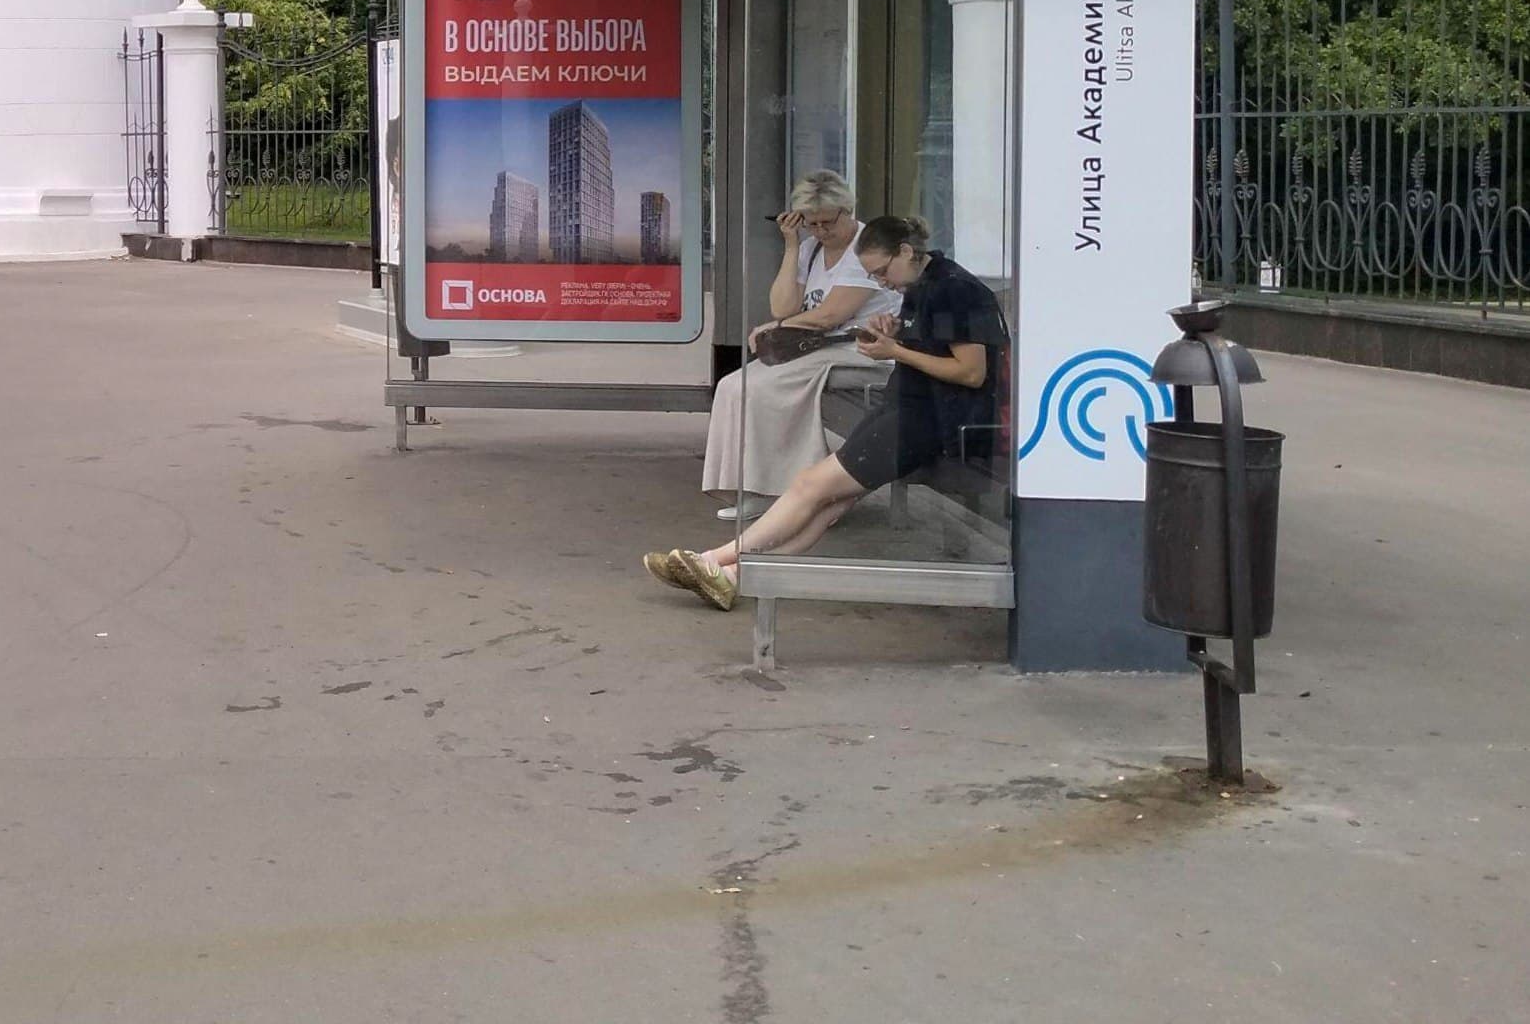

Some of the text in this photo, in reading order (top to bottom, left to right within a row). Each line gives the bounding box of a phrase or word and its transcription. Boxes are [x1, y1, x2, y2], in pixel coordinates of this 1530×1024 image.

[445, 18, 647, 52] В ОСНОВЕ ВЫБОРА
[1115, 26, 1134, 82] Ulitsa
[445, 65, 647, 85] ВЫДАЕМ КЛЮЧИ
[1074, 156, 1106, 251] Улица
[477, 288, 547, 304] ОСНОВА
